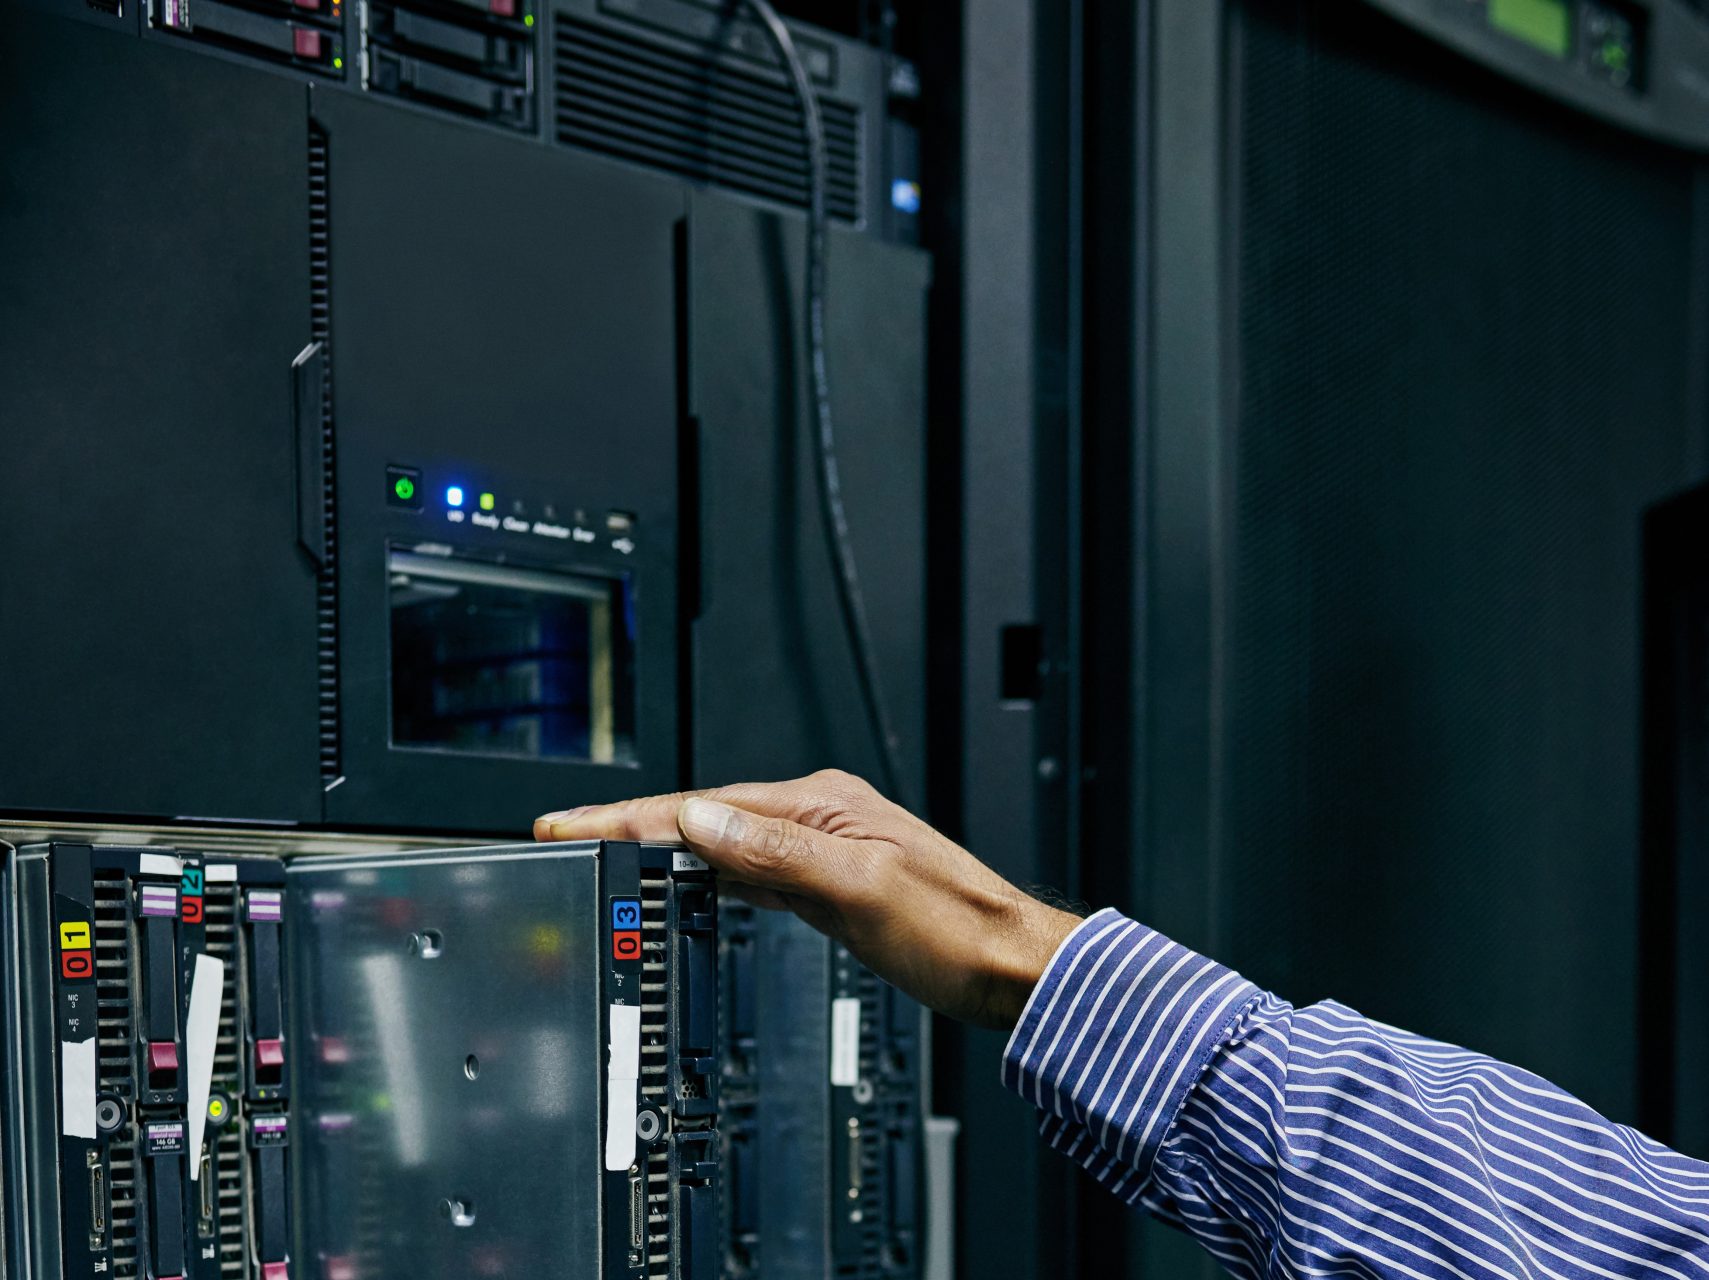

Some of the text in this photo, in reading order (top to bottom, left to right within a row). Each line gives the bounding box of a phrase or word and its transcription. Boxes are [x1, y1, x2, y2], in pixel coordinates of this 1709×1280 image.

[67, 994, 79, 1002] NIC
[71, 1001, 76, 1009] 3
[68, 1018, 80, 1026] NIC
[156, 1138, 166, 1146] 146
